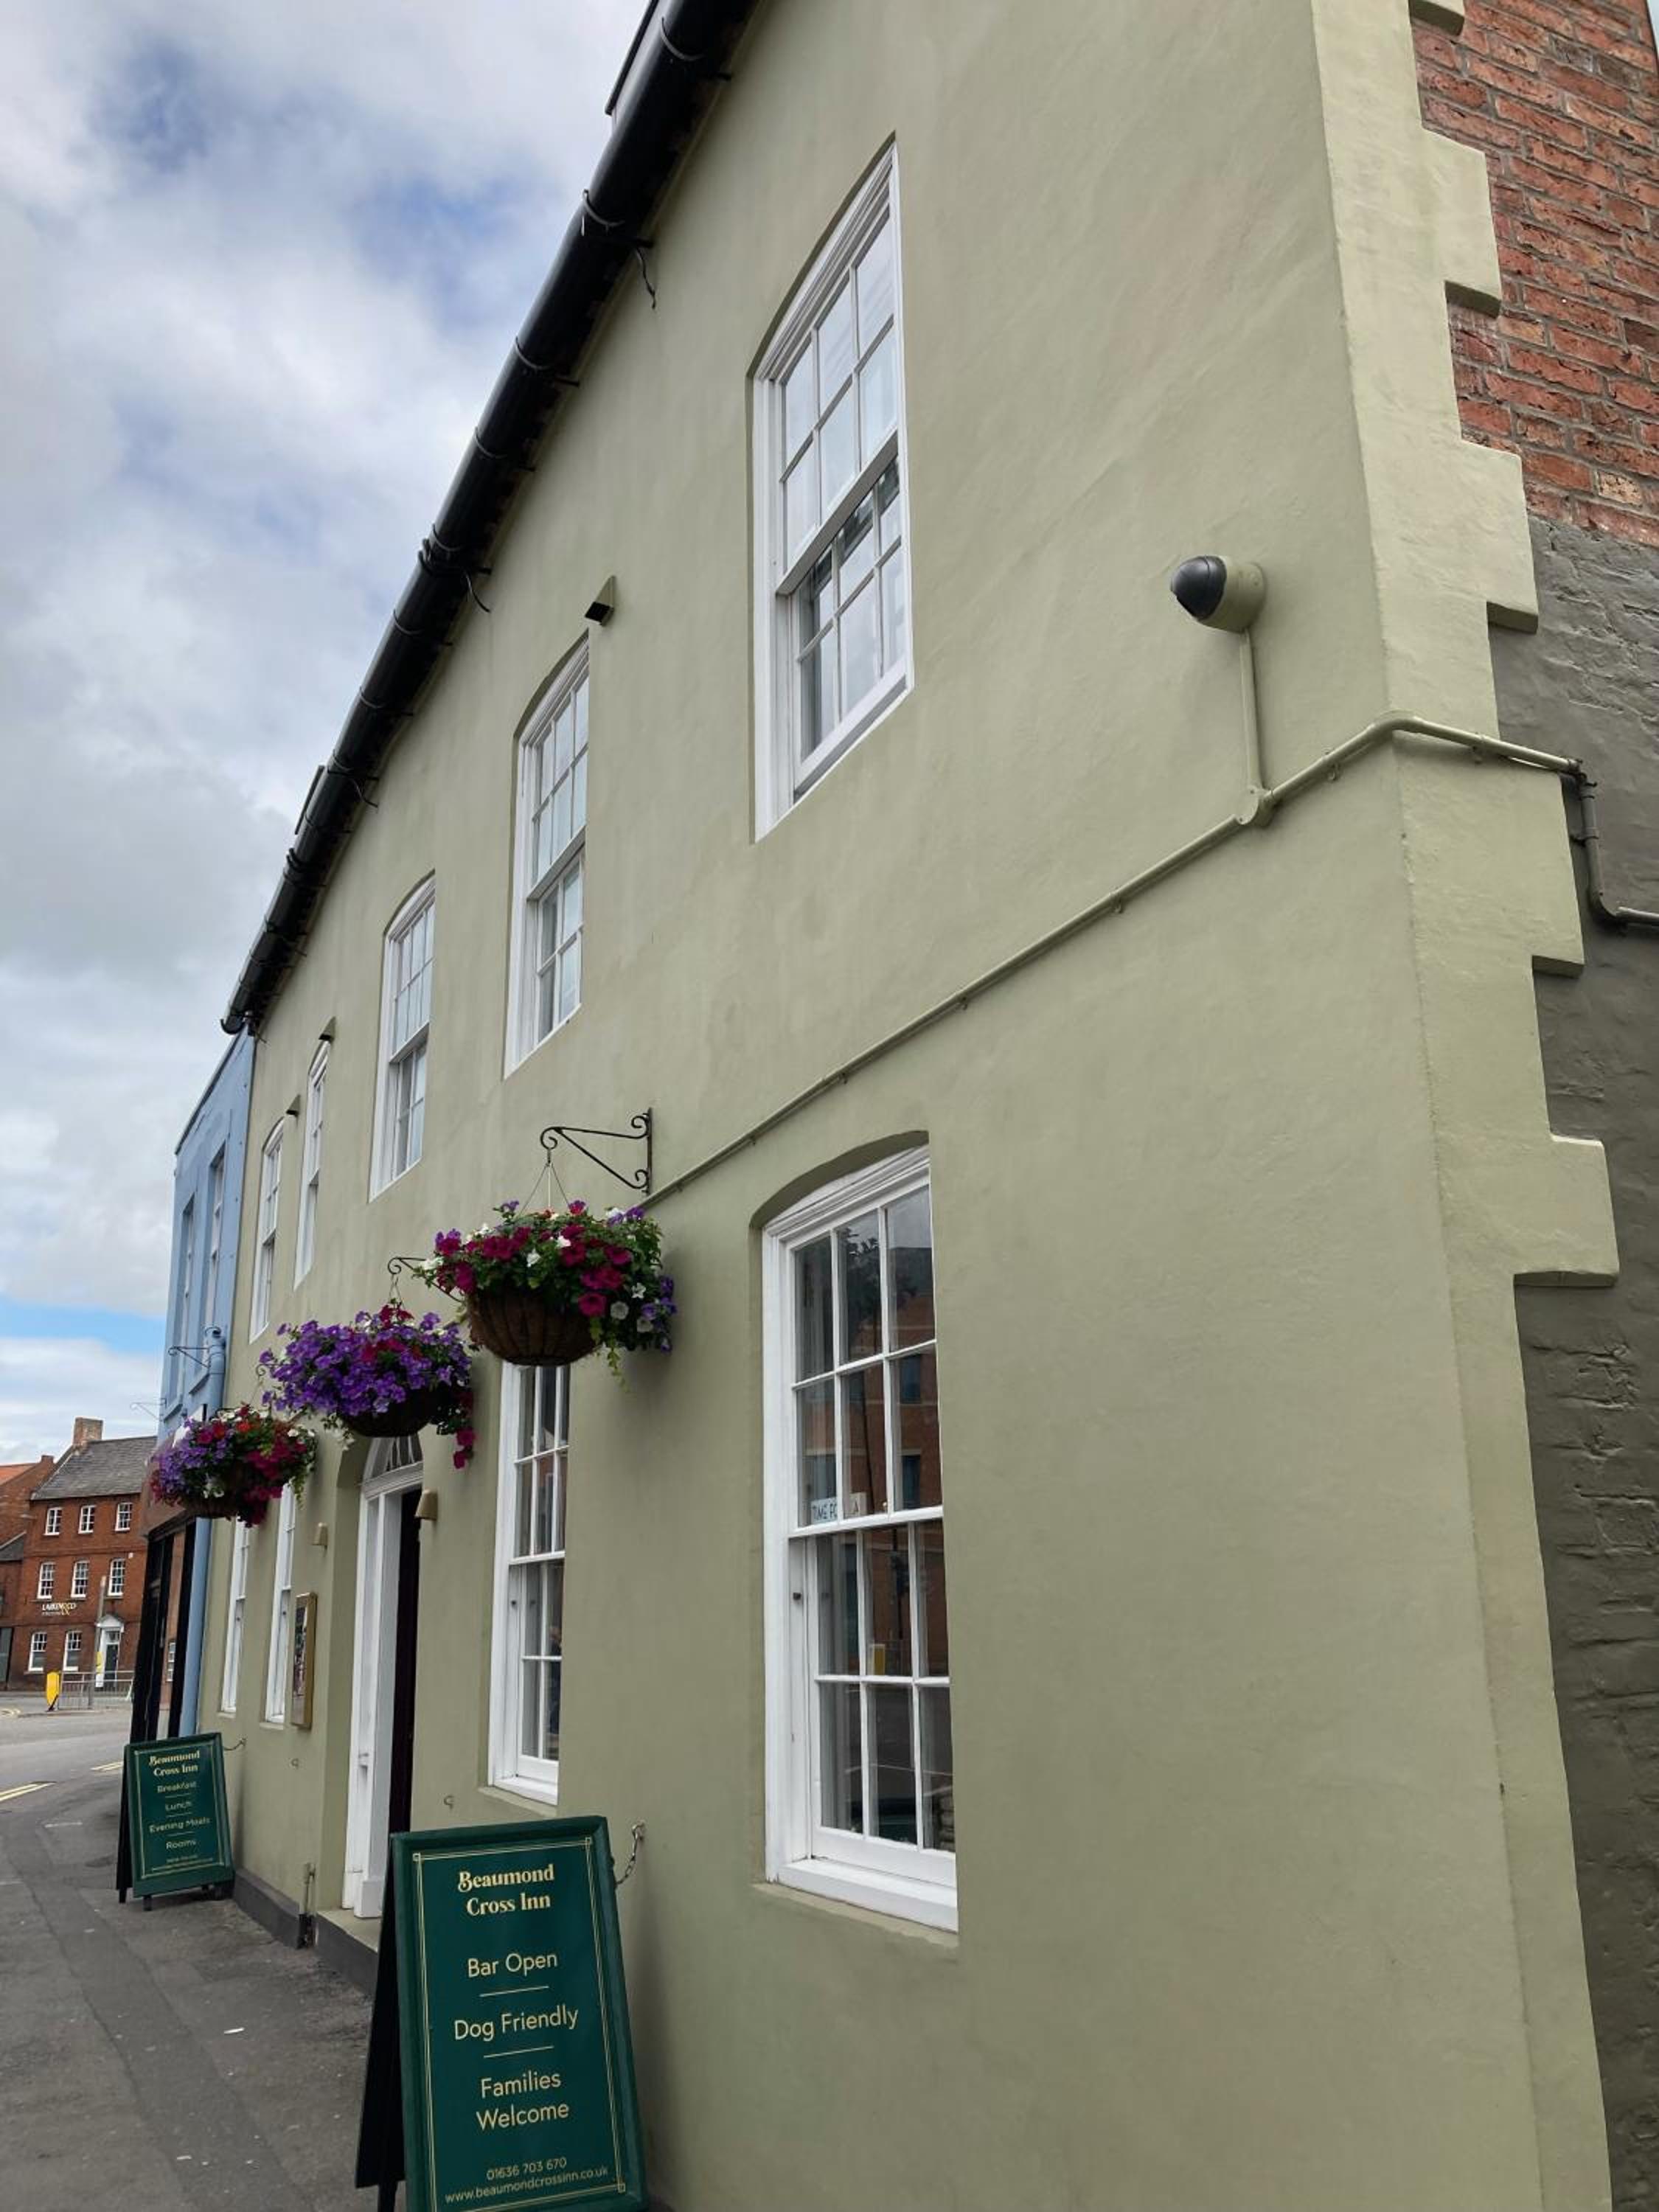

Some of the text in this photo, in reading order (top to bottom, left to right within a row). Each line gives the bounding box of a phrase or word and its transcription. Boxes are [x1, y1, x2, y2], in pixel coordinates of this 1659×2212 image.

[149, 1750, 200, 1766] Beaumond
[153, 1764, 198, 1776] Cross Inn
[157, 1781, 197, 1793] Breakfast
[165, 1801, 192, 1811] Lunch
[149, 1822, 184, 1833] Evening
[458, 1864, 554, 1893] Beaumond
[466, 1893, 551, 1916] Cross Inn
[467, 1953, 557, 1978] Bar Open
[454, 2003, 579, 2042] Dog Friendly
[481, 2070, 562, 2099] Families
[476, 2104, 569, 2131] Welcome
[486, 2156, 567, 2180] 01636 703 670
[445, 2166, 608, 2204] www.beaumondcrossinn.co.uk
